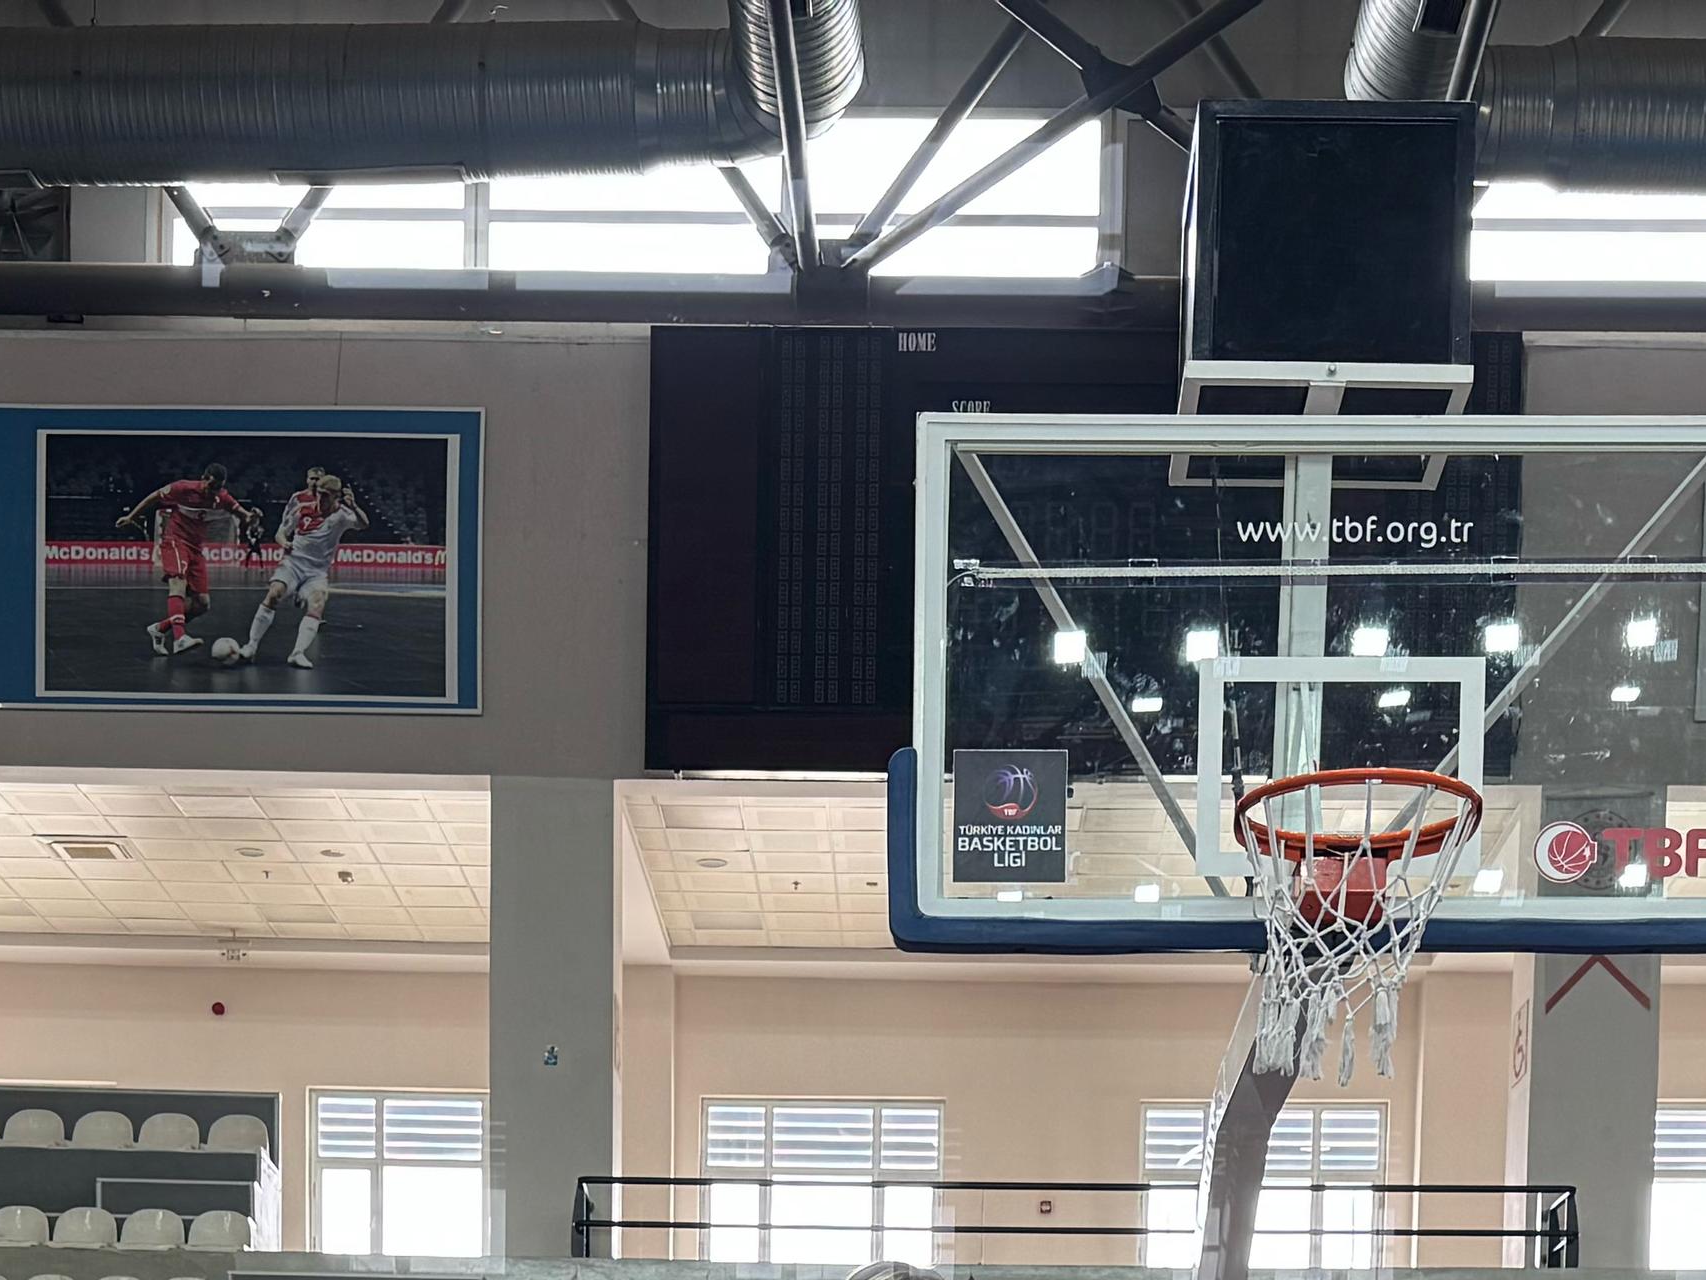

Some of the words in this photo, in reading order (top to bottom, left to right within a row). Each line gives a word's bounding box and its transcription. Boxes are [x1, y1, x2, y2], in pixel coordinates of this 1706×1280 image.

[898, 332, 936, 352] HOME
[1236, 515, 1474, 549] www.tbf.org.tr
[337, 547, 433, 564] McDonald's
[958, 824, 1005, 836] TÜRKİYE
[1006, 824, 1062, 836] KADINLAR
[958, 836, 1062, 851] BASKETBOL
[993, 851, 1026, 868] LİGİ
